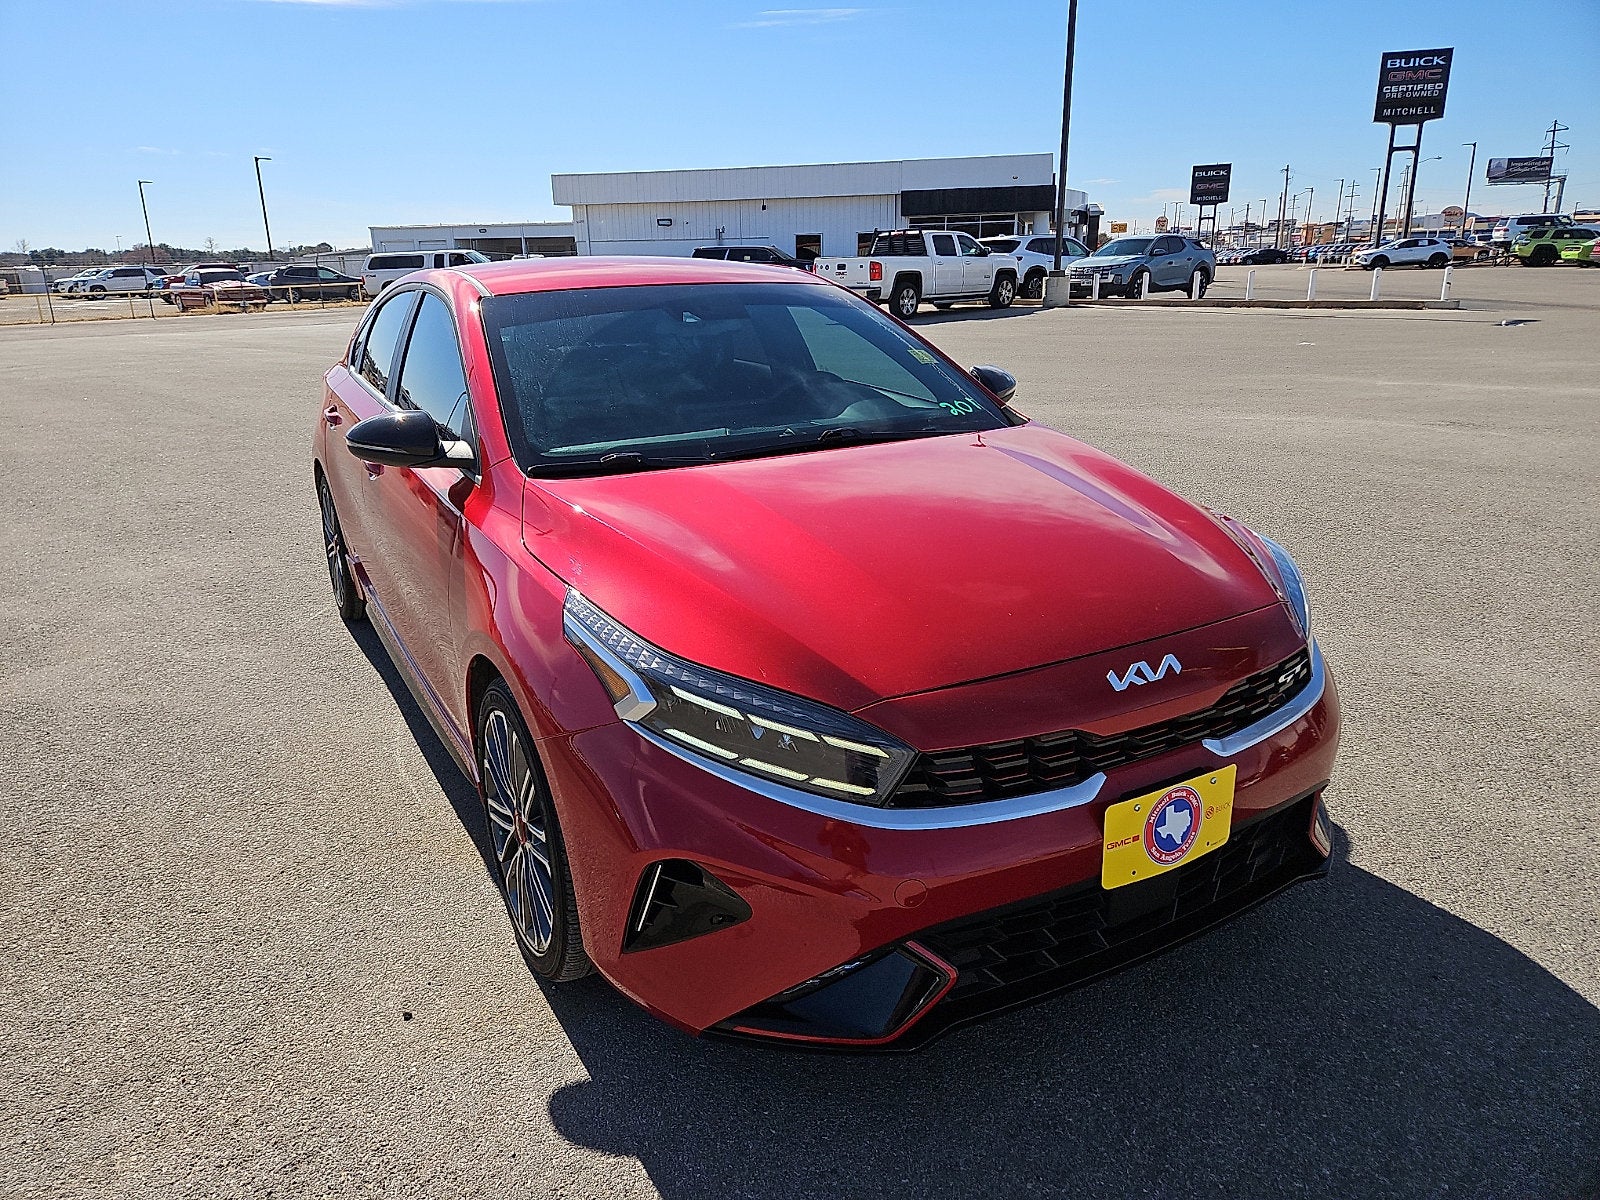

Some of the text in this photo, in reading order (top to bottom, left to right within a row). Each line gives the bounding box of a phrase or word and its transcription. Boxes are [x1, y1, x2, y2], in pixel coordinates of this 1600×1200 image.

[1387, 56, 1446, 68] BUICK
[1388, 69, 1442, 81] GMC
[1382, 82, 1444, 93] CERTIFIED
[1385, 89, 1439, 99] PRE-OWNED
[1382, 106, 1436, 117] MITCHELL
[1196, 182, 1225, 190] GMC
[1106, 653, 1182, 692] KIA
[1149, 797, 1169, 824] Mitchell
[1171, 790, 1187, 799] Buick
[1106, 837, 1132, 850] GMC
[1150, 846, 1161, 858] San
[1182, 831, 1196, 851] Texas
